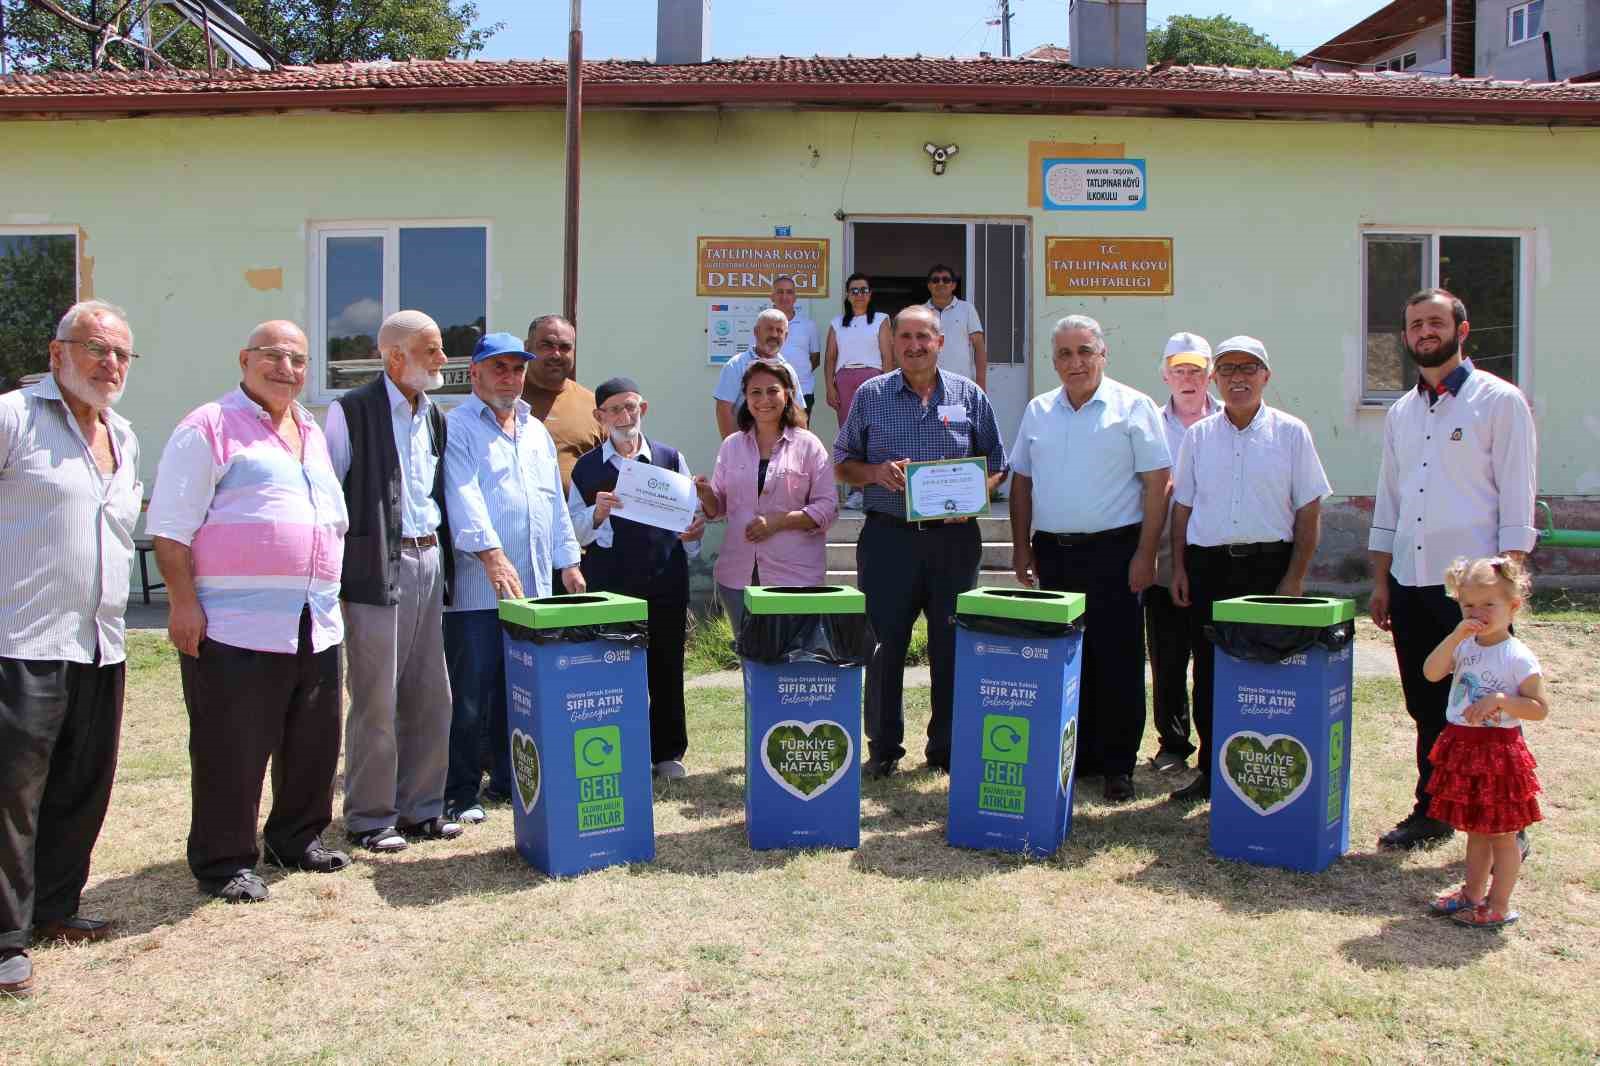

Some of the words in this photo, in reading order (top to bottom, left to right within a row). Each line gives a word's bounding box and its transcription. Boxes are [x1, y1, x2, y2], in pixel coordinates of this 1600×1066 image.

[1086, 178, 1122, 188] TATLIPINAR
[1054, 260, 1128, 271] TATLIPINAR
[708, 269, 817, 288] DERNĞİ
[778, 684, 806, 693] SIFIR
[810, 684, 836, 693] ATIK
[980, 686, 1007, 697] SIFIR
[1010, 689, 1037, 700] ATIK
[567, 699, 594, 711] SIFIR
[598, 695, 624, 707] ATIK
[1237, 694, 1266, 705] SIFIR
[1269, 696, 1296, 708] ATIK
[780, 737, 836, 750] TÜRKİYE
[786, 751, 829, 763] ÇEVRE
[1238, 750, 1295, 766] TÜRKİYE
[780, 762, 834, 772] HAFTASI
[985, 762, 1023, 785] GERİ
[1243, 763, 1288, 778] ÇEVRE
[1237, 773, 1292, 789] HAFTASI
[580, 775, 620, 802] GERİ
[582, 811, 621, 828] ATIKLAR
